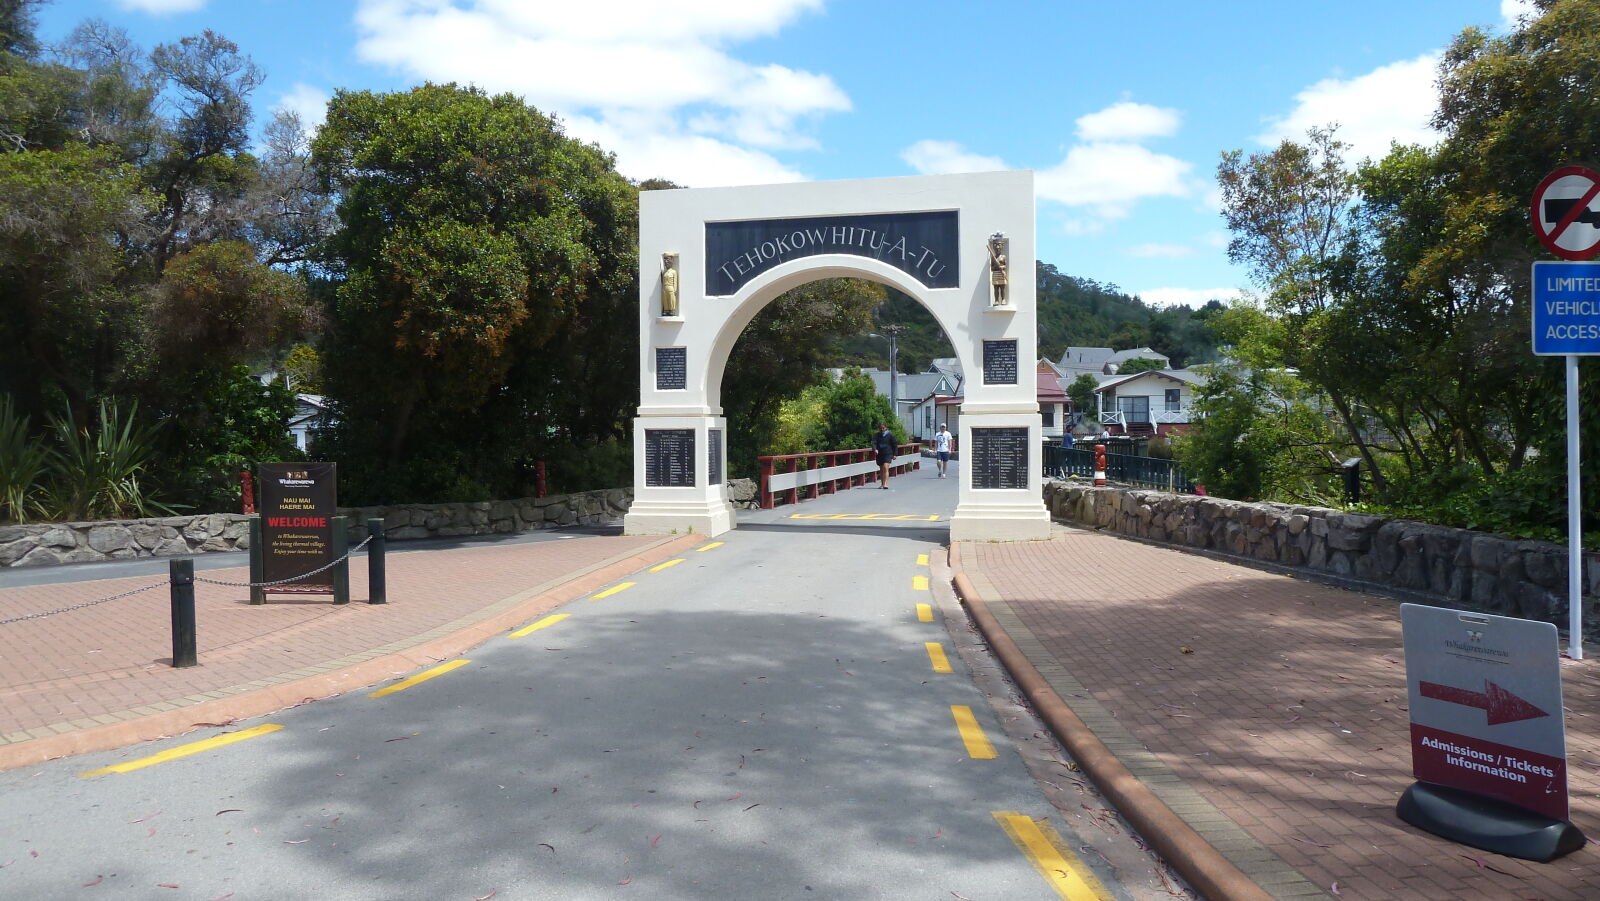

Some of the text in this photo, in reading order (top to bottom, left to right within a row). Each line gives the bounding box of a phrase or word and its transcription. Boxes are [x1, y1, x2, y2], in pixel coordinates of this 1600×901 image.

[1545, 301, 1600, 315] VEHICL
[1545, 324, 1600, 339] ACCES
[268, 517, 326, 527] WELCOME
[1421, 736, 1554, 777] Admissions / Tickets
[1446, 754, 1527, 783] Information
